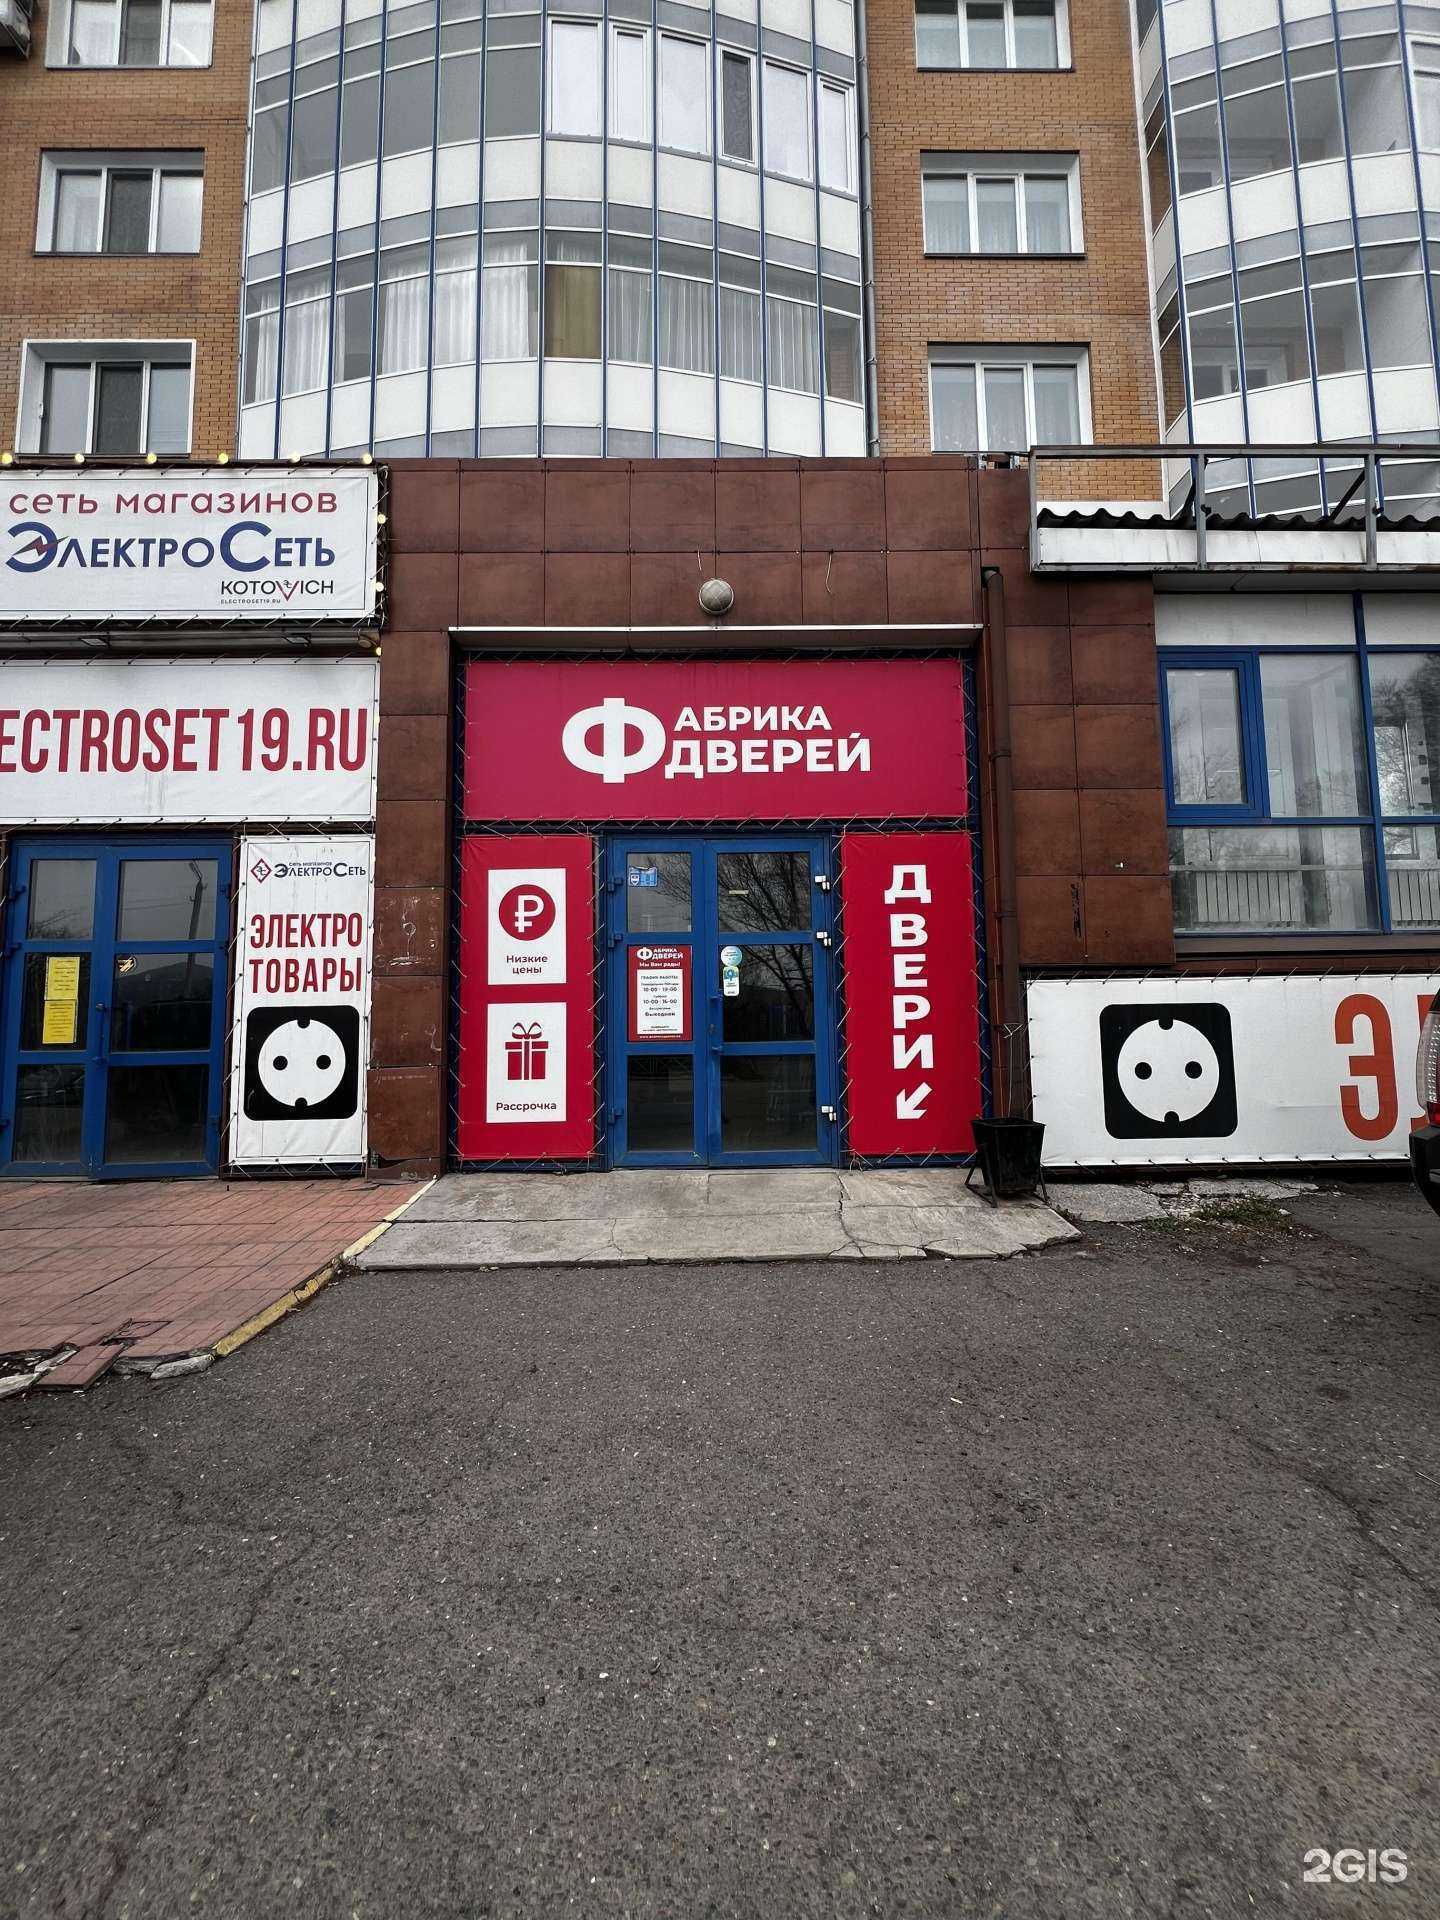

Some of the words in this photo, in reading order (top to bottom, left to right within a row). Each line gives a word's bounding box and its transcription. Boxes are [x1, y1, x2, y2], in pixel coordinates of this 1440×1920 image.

[9, 492, 98, 515] сеть
[115, 491, 338, 515] магазинов
[221, 580, 334, 601] KOTOVICH
[0, 708, 368, 773] ECTROSET19.RU
[561, 697, 832, 784] ФАБРИКА
[664, 732, 871, 779] ДВЕРЕЙ
[250, 912, 362, 948] ЭЛЕКТРО
[249, 957, 362, 993] ТОВАРЫ
[506, 954, 548, 964] Низкие
[512, 966, 542, 975] цены
[884, 864, 933, 1069] ДВЕРИ
[496, 1101, 557, 1112] Рассрочка
